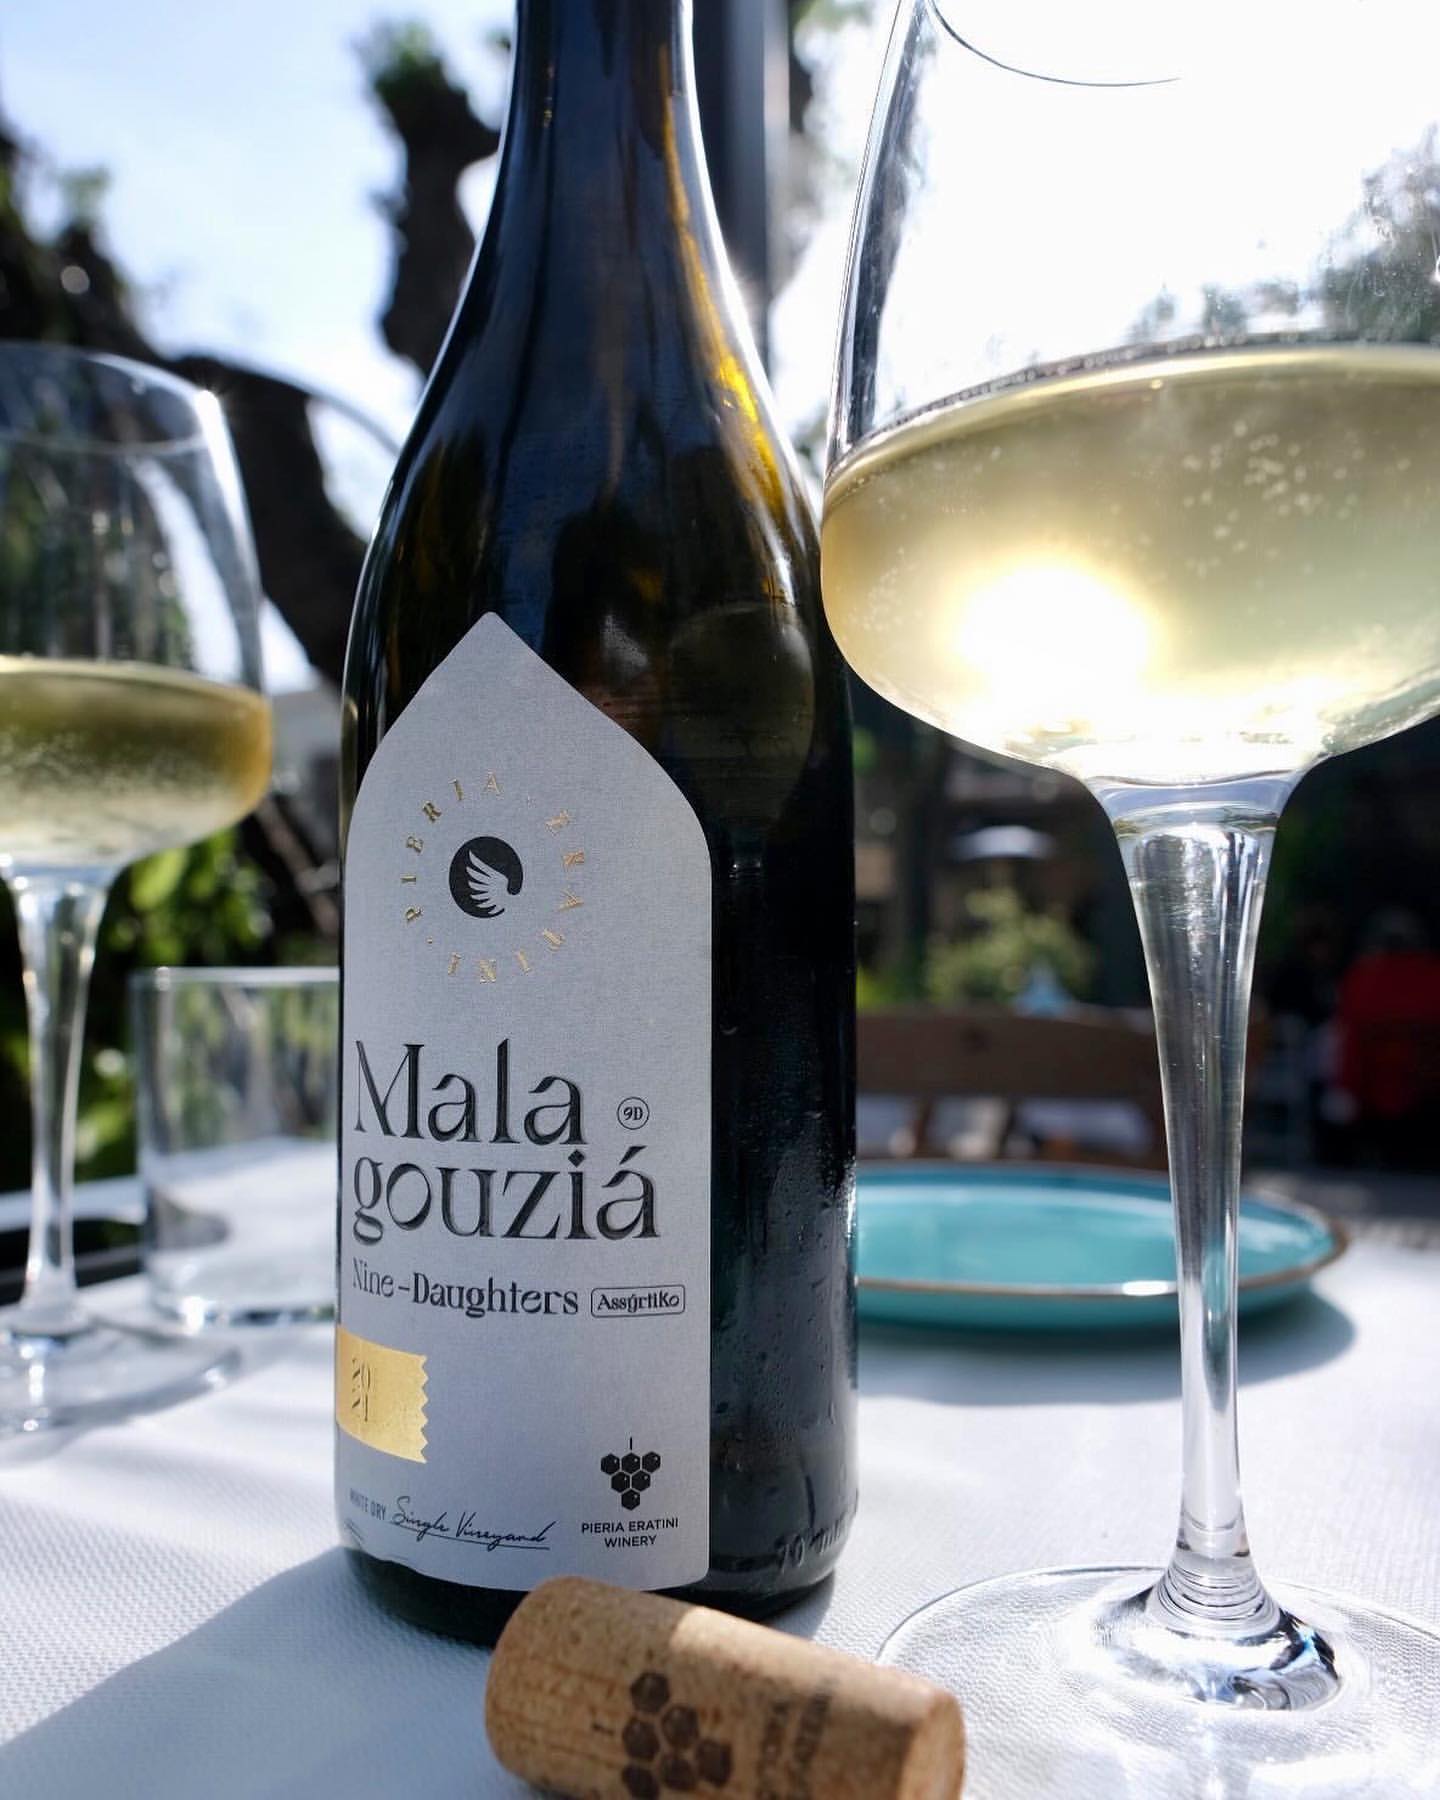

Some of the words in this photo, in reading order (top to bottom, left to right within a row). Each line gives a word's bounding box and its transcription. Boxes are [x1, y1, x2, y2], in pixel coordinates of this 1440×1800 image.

[353, 1038, 588, 1145] Mala
[352, 1146, 661, 1245] gouziá
[370, 1501, 387, 1520] DRY
[391, 1496, 449, 1542] Single
[456, 1512, 556, 1551] Vineyard
[581, 1522, 625, 1534] PIERIA
[628, 1517, 679, 1532] ERATINI
[604, 1535, 657, 1548] WINERY
